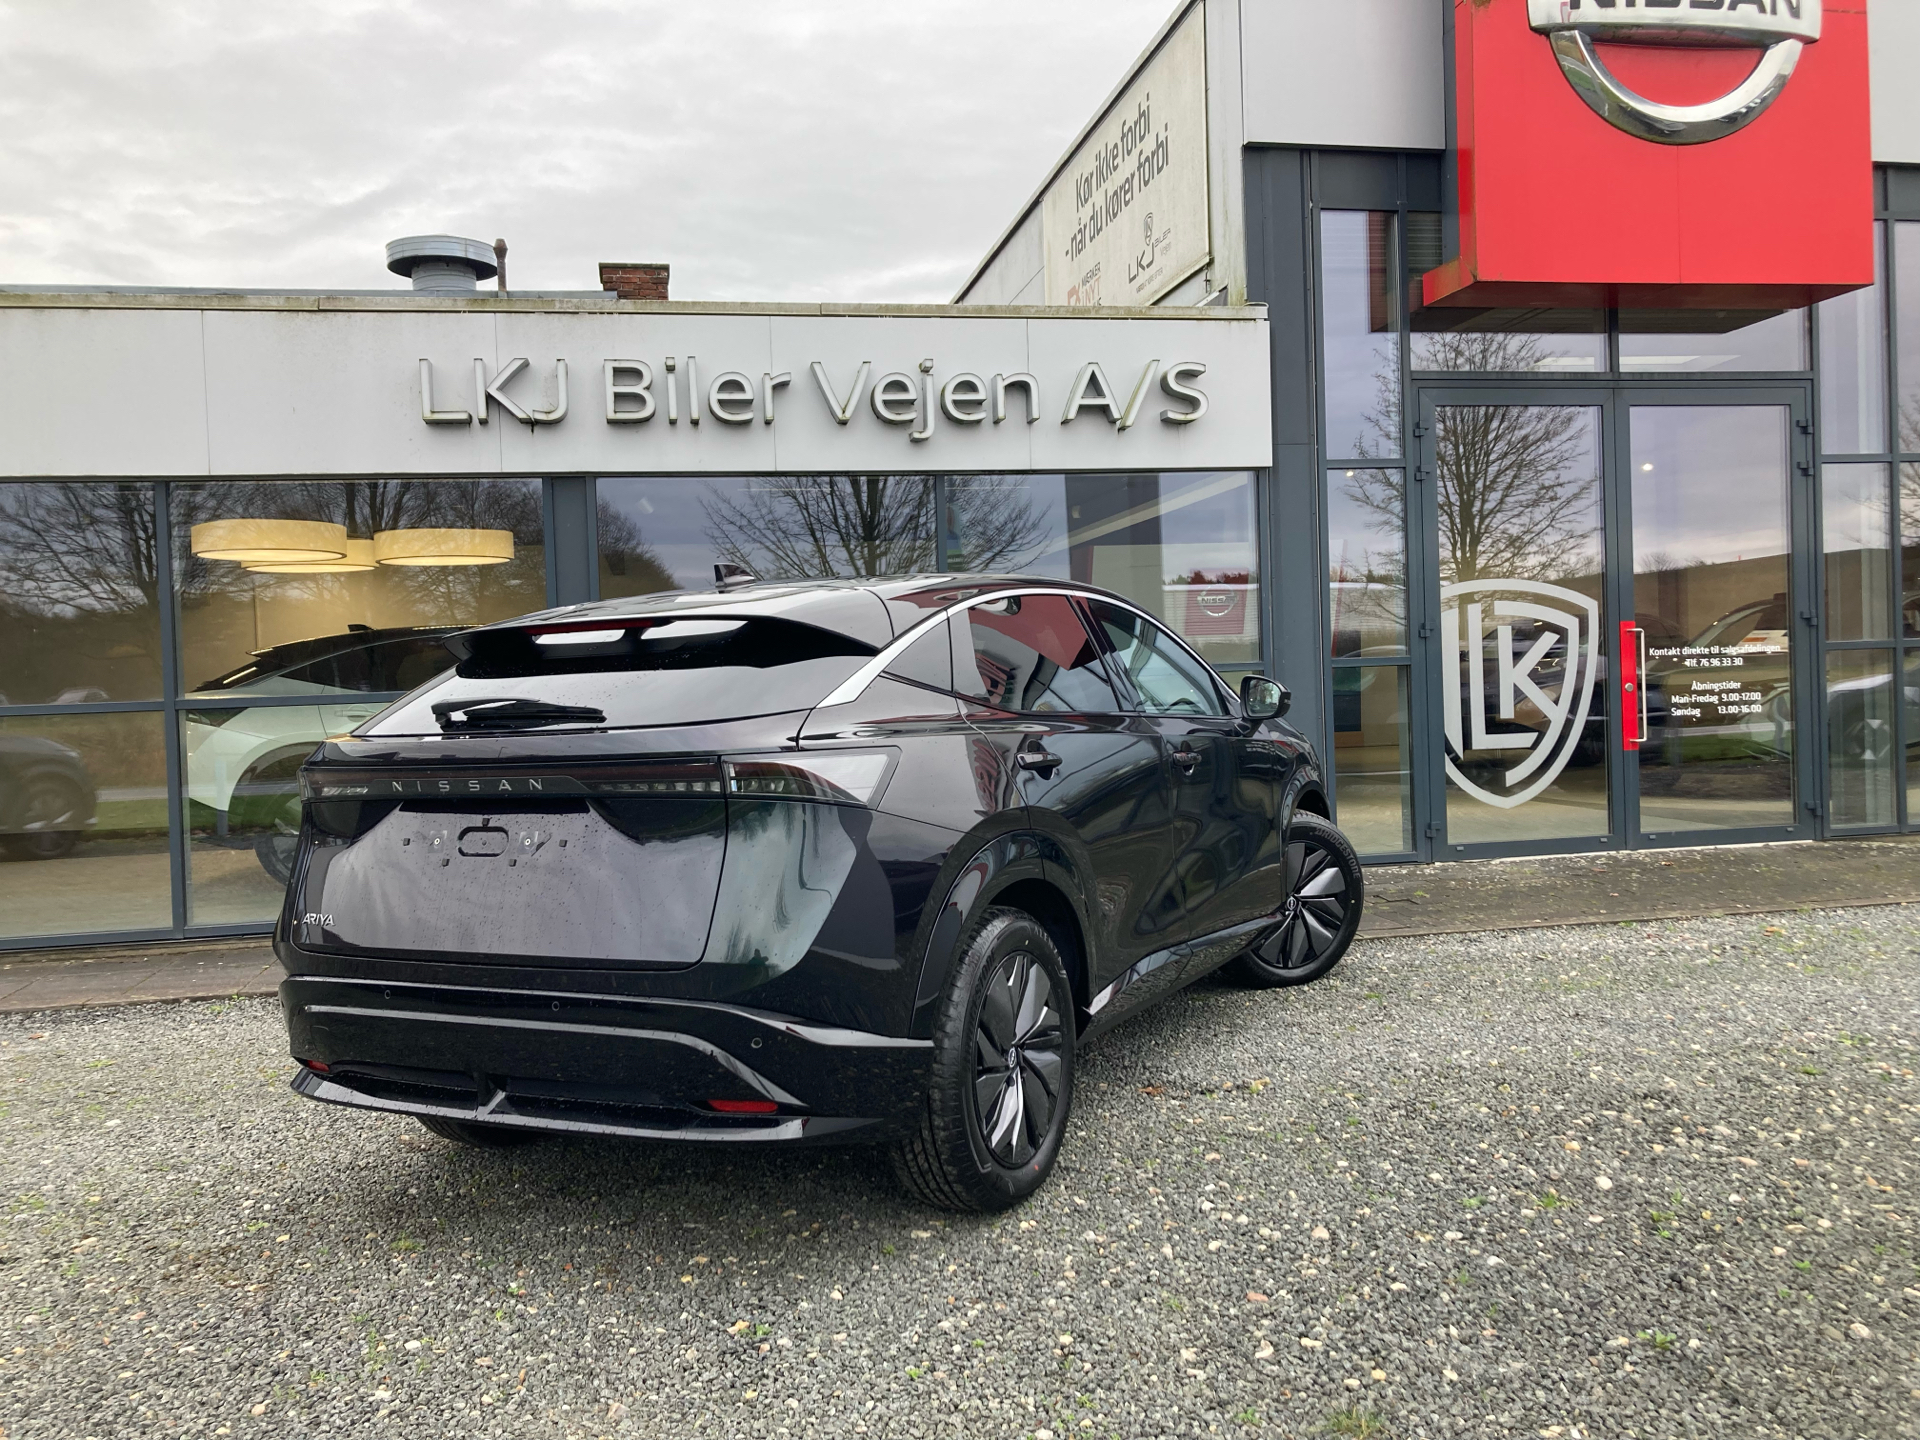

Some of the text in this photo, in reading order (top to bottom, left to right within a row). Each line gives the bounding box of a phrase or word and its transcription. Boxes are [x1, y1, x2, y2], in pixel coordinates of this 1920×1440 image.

[1075, 91, 1150, 214] Kør ikke forbi
[1089, 201, 1103, 243] du
[1104, 168, 1136, 228] kører
[1137, 121, 1169, 194] forbi
[1128, 241, 1155, 284] LKJ
[418, 355, 1208, 442] LKJ Biler Vejen A/S
[1649, 644, 1781, 656] Kontakt direkte til salgsafdelingen
[1699, 658, 1709, 667] 76
[1710, 657, 1721, 667] 96
[1721, 657, 1731, 666] 33
[1732, 657, 1743, 666] 30
[1691, 680, 1742, 692] Åbningstider
[1671, 692, 1762, 704] Man-Fredag 9.00-17.00
[1671, 705, 1762, 717] Søndag 13.00-16.00
[391, 778, 543, 792] NISSAN
[1314, 826, 1361, 879] BRIDGESTONE
[302, 912, 335, 927] ARIYA
